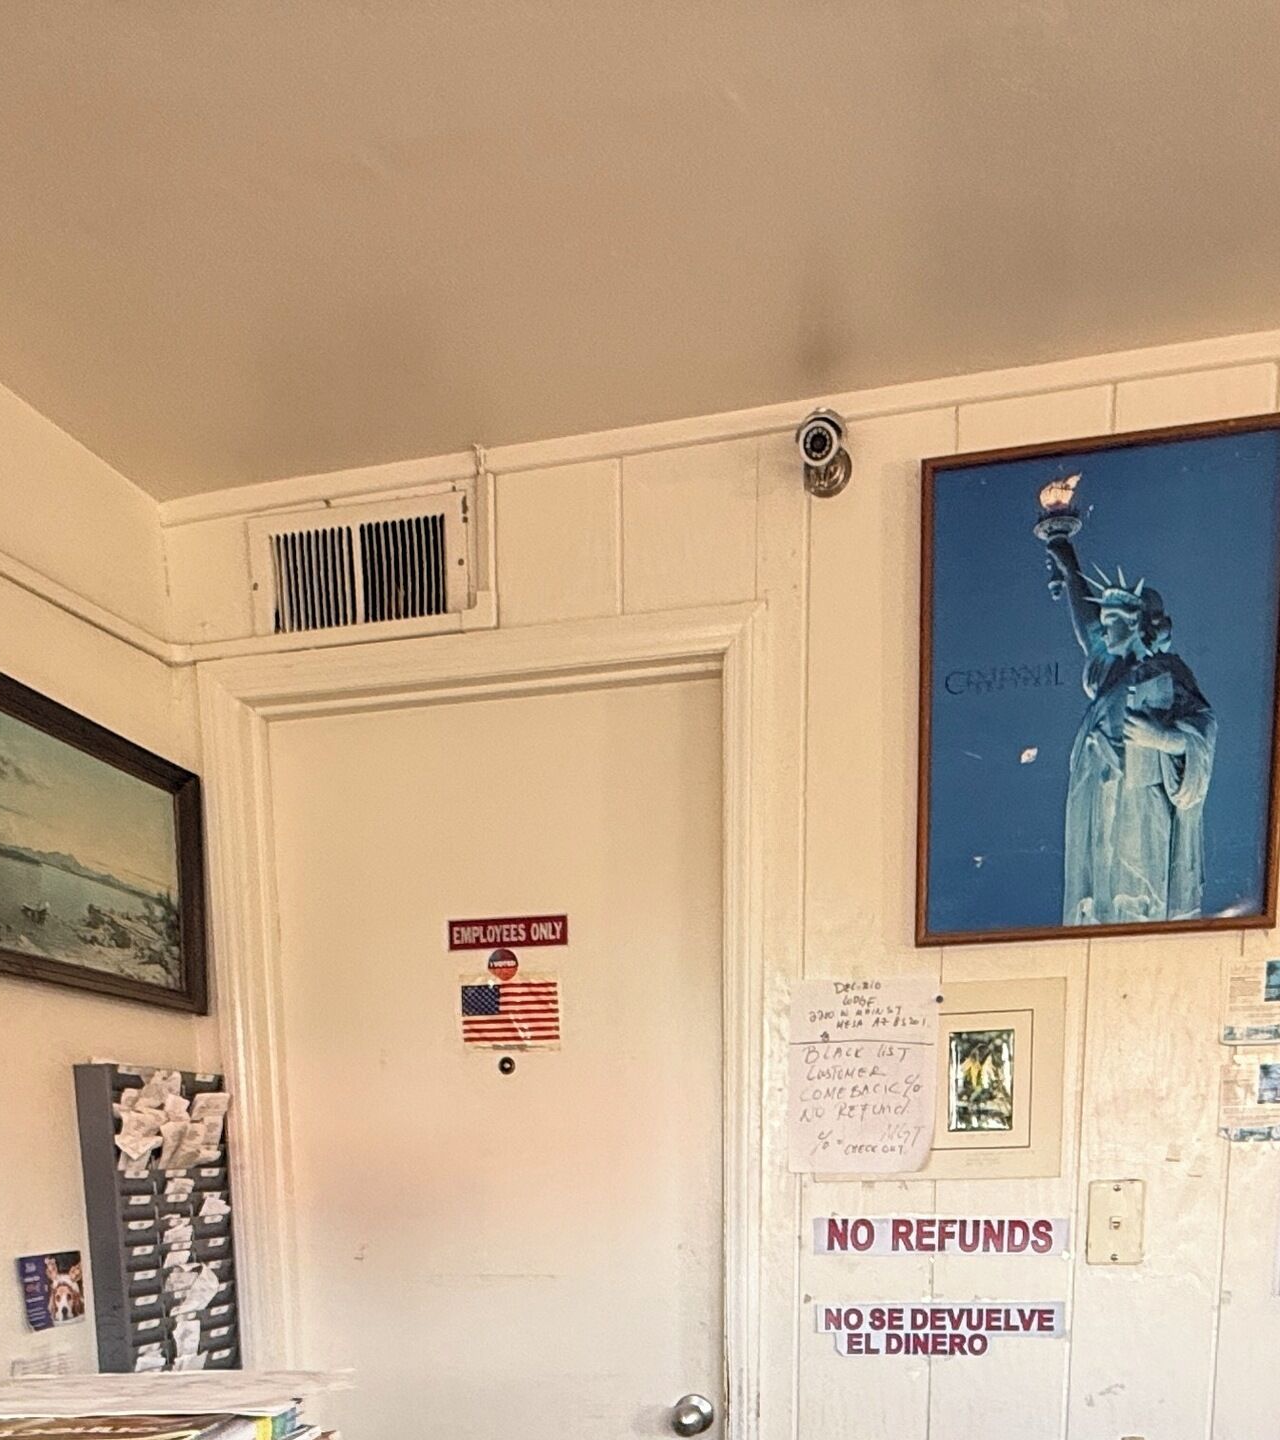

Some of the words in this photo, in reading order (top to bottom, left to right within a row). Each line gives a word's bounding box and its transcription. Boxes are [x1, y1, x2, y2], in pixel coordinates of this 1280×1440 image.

[453, 923, 526, 945] EMPLOYEES
[530, 921, 563, 941] ONLY
[799, 1107, 825, 1122] NO
[827, 1218, 875, 1251] NO
[891, 1218, 1053, 1254] REFUNDS
[824, 1308, 864, 1331] NO
[869, 1308, 904, 1331] SE
[910, 1308, 1055, 1332] DEVUELVE
[847, 1333, 880, 1355] EL
[885, 1333, 989, 1356] DINERO
